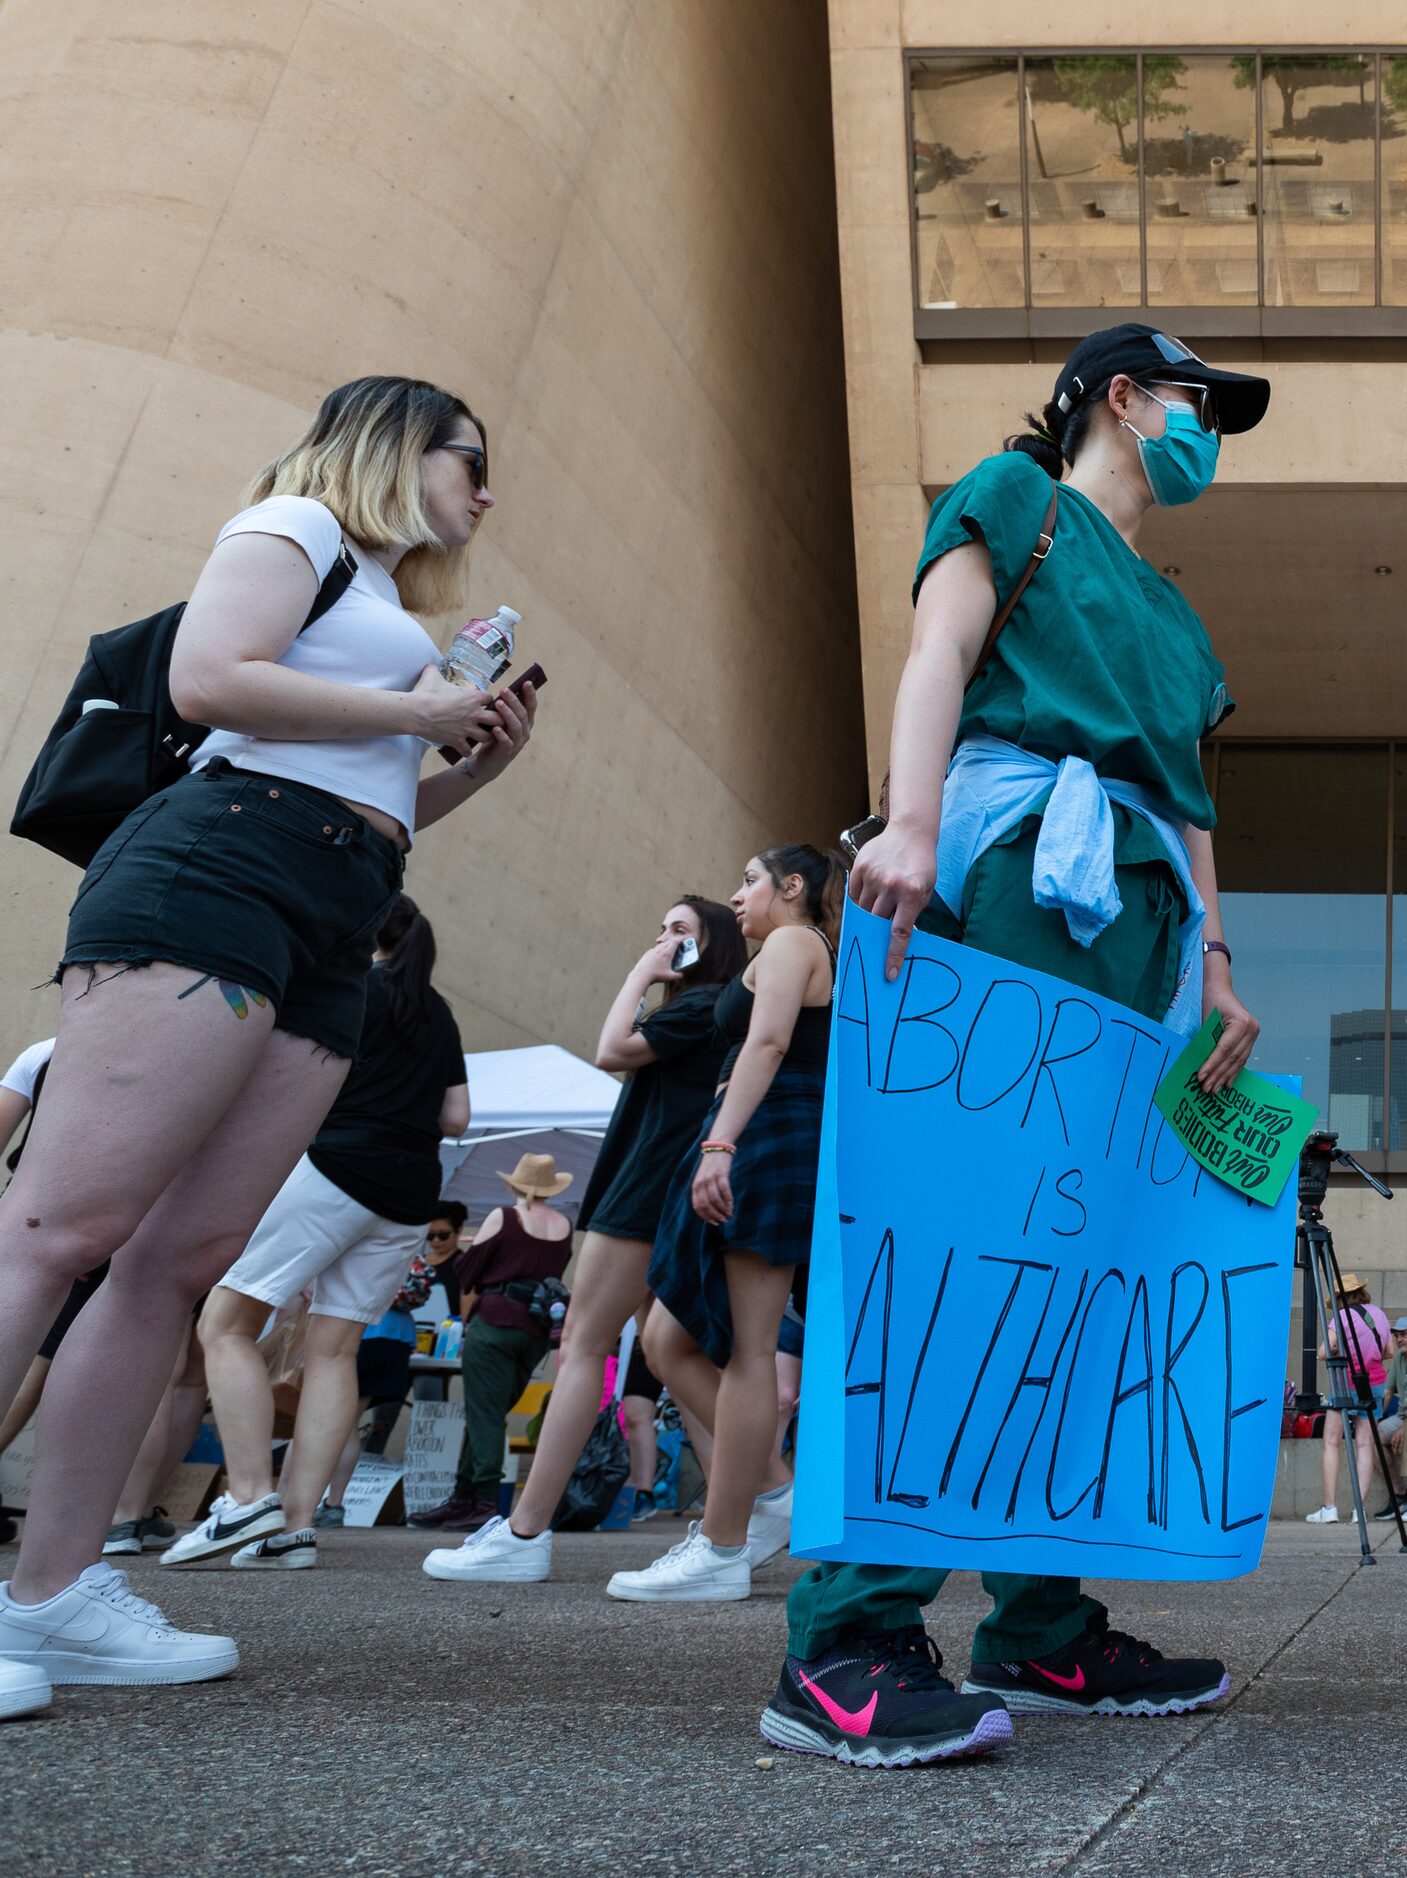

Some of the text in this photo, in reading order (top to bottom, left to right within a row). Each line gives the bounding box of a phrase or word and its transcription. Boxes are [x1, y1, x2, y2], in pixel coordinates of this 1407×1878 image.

[1172, 1097, 1271, 1190] Our BODIES
[1233, 1119, 1281, 1159] OUR
[1251, 1103, 1294, 1137] Our
[1022, 1168, 1087, 1236] IS
[840, 1214, 1280, 1532] ALTHCARE
